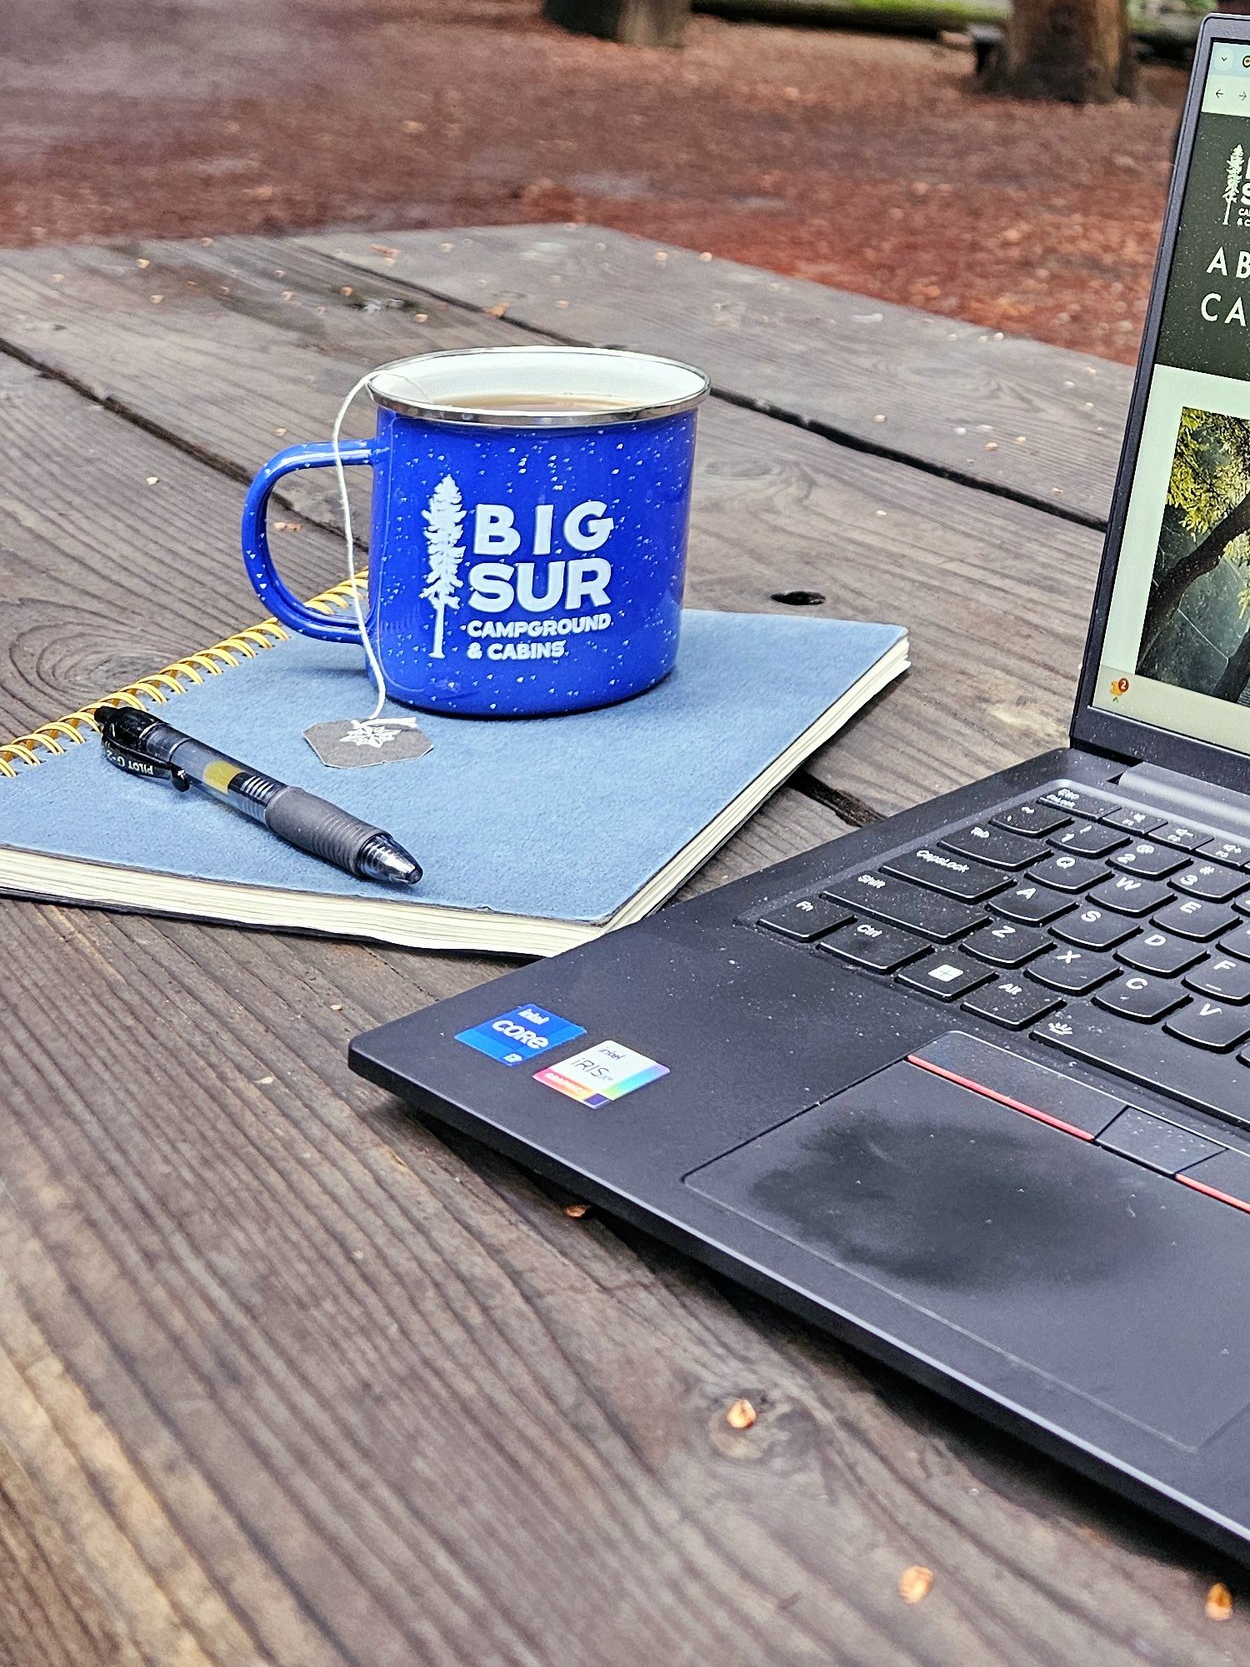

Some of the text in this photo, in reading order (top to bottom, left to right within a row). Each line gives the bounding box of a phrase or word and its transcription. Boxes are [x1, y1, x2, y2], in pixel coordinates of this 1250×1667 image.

[473, 500, 615, 556] BIG
[468, 557, 612, 613] SUR
[466, 613, 612, 639] CAMPGROUND
[466, 640, 567, 661] & CABINS
[128, 760, 154, 775] PILOT
[915, 848, 970, 873] CapsLock
[1055, 856, 1076, 869] Q
[1115, 876, 1142, 892] W
[1016, 886, 1037, 900] A
[796, 900, 814, 912] Fn
[1180, 901, 1202, 915] E
[1081, 909, 1102, 924] S
[857, 923, 883, 938] Ctrl
[992, 924, 1016, 938] Z
[1144, 933, 1167, 947] D
[1056, 949, 1082, 964] X
[999, 983, 1023, 997] Alt
[1126, 977, 1149, 991] C
[1198, 1003, 1223, 1019] V
